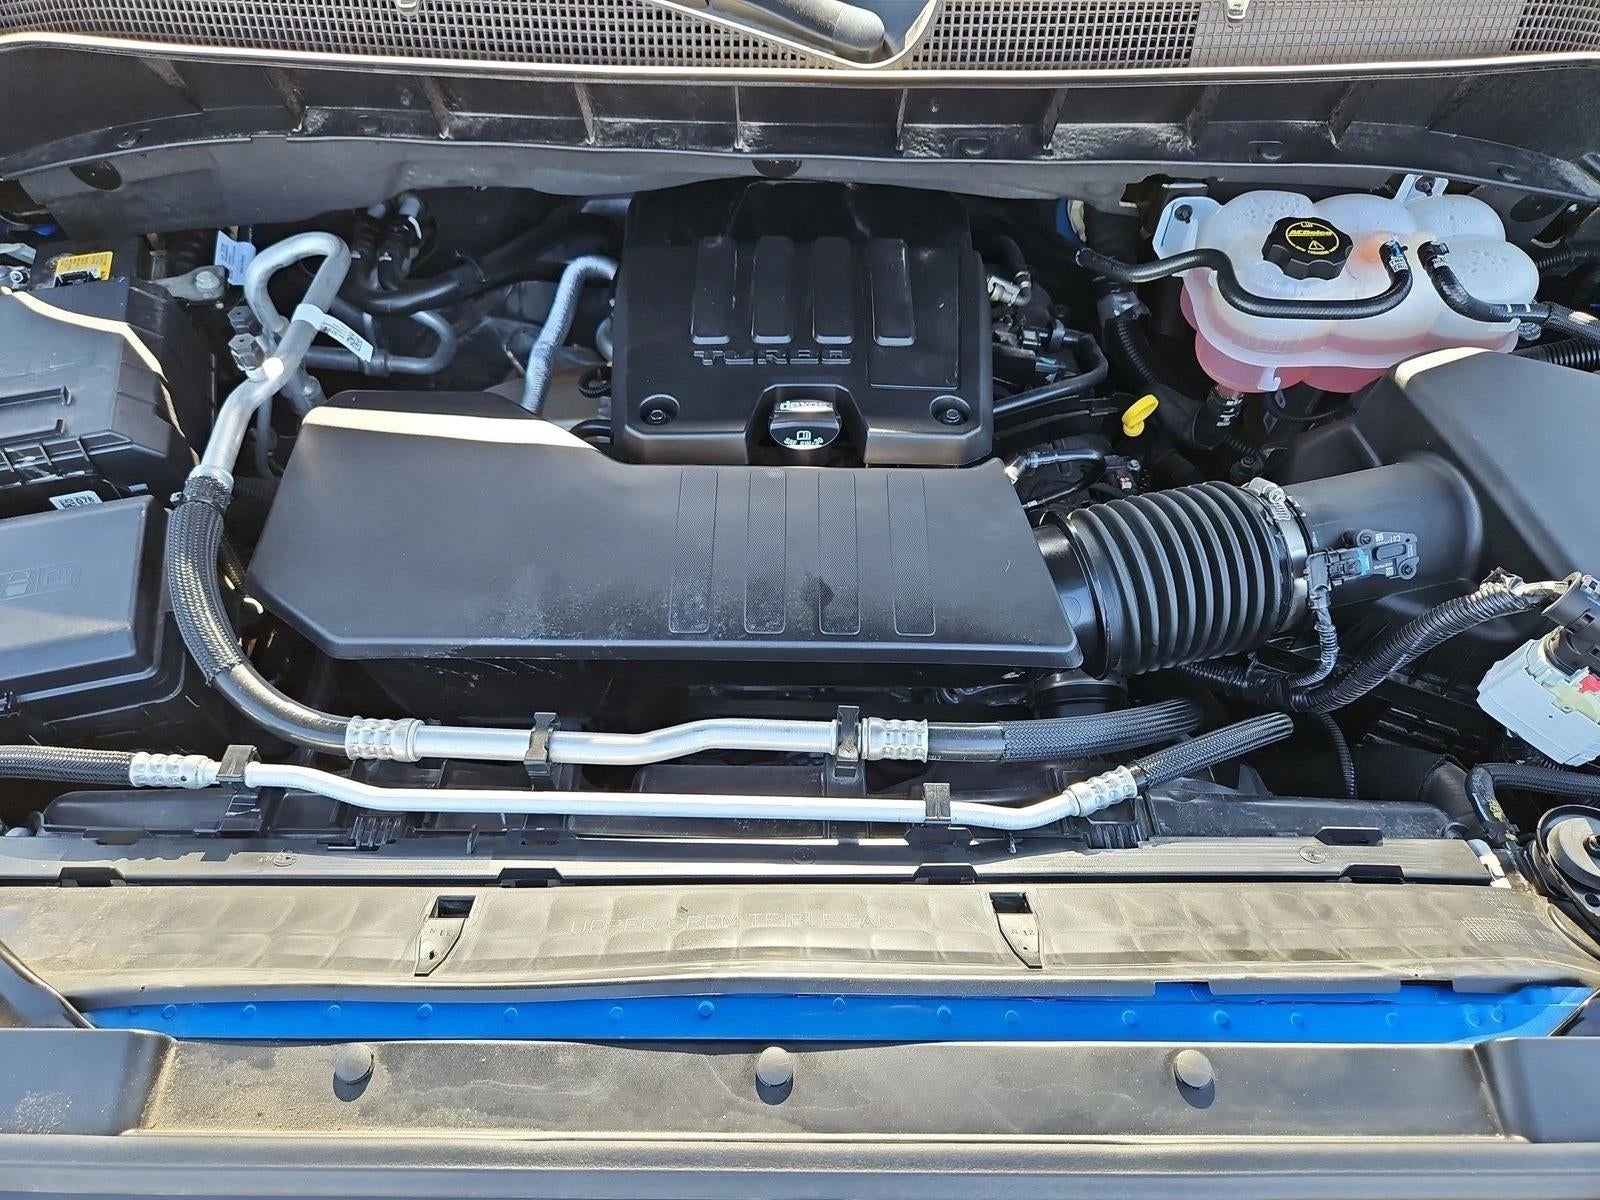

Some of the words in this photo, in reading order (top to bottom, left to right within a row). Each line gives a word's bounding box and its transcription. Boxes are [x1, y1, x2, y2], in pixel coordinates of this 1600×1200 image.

[693, 350, 851, 365] TURBO
[570, 917, 658, 935] UPPER
[748, 912, 838, 928] TRIPLE
[846, 912, 896, 928] FAN
